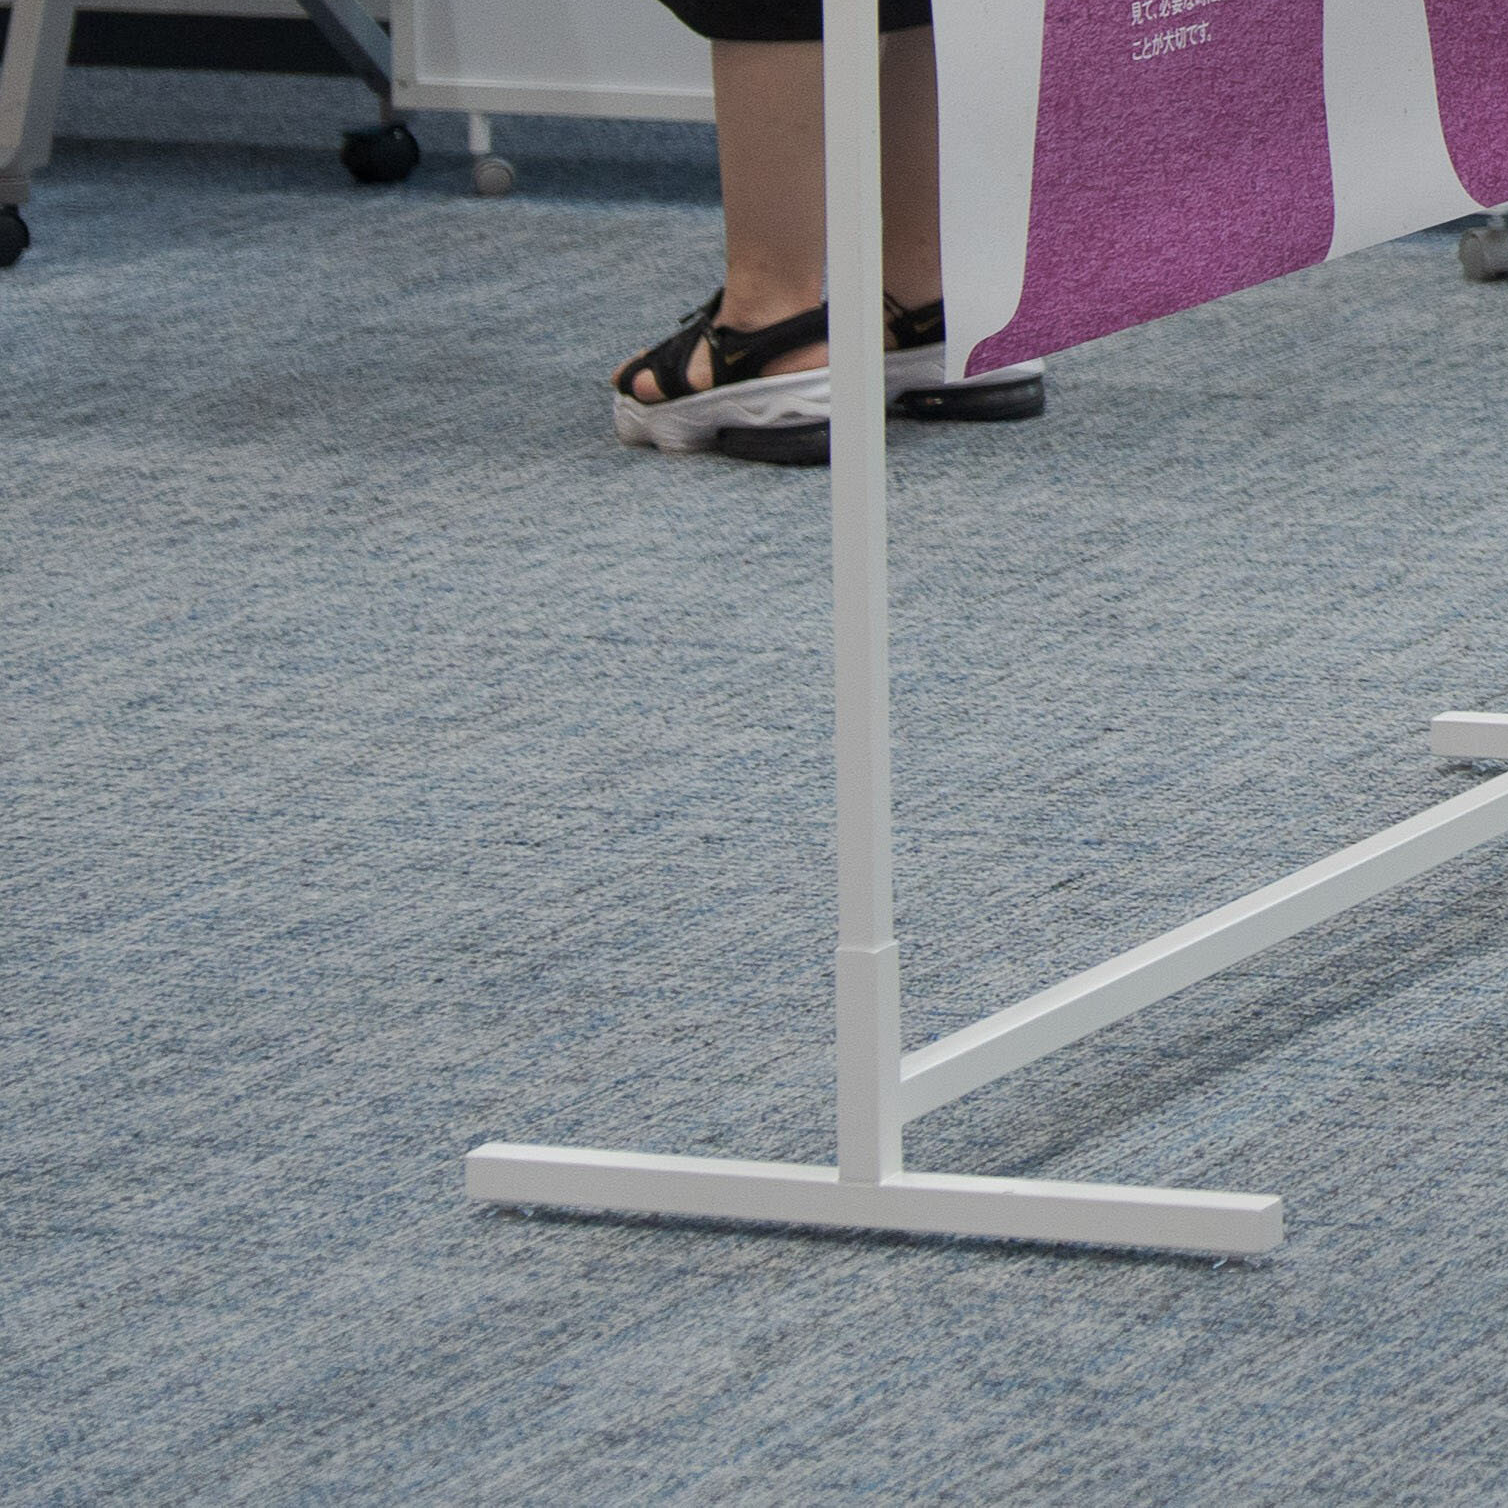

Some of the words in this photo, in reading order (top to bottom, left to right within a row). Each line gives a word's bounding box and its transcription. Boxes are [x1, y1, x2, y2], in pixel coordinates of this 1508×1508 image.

[1131, 21, 1214, 62] ことが大切です。
